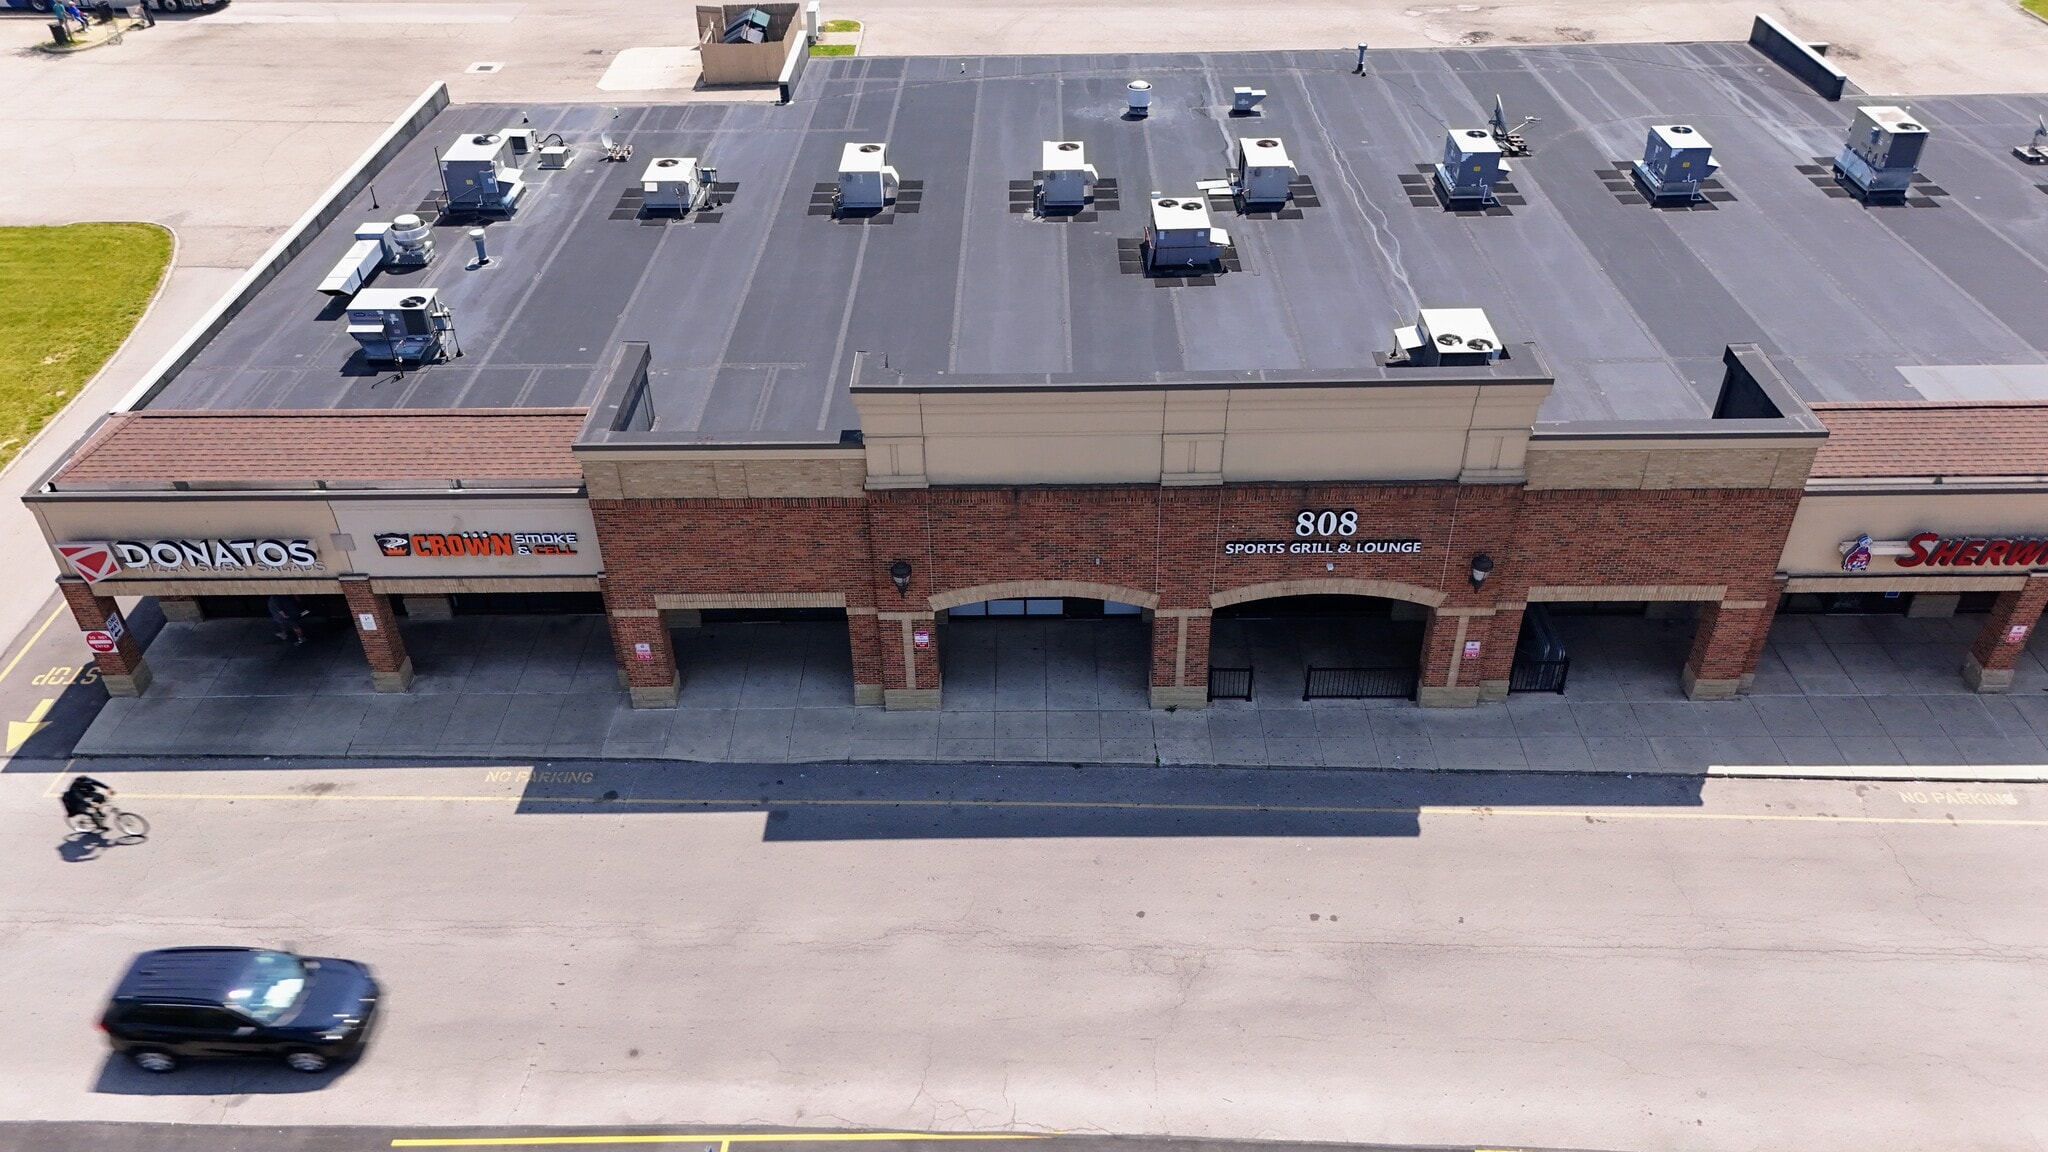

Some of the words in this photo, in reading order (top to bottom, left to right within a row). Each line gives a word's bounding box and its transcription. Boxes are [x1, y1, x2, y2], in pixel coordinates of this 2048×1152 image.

[1295, 511, 1358, 537] 808
[411, 533, 514, 556] CROWN
[514, 534, 577, 544] SMOKE
[115, 541, 316, 568] DONATOS
[518, 546, 532, 556] &
[534, 545, 577, 555] CELL
[1225, 543, 1285, 554] SPORTS
[1289, 542, 1333, 554] GRILL
[1337, 543, 1351, 553] &
[1356, 542, 1421, 553] LOUNGE
[31, 667, 102, 685] STOP
[485, 770, 512, 783] NO
[515, 770, 594, 783] PARKING
[1900, 791, 1928, 803] NO
